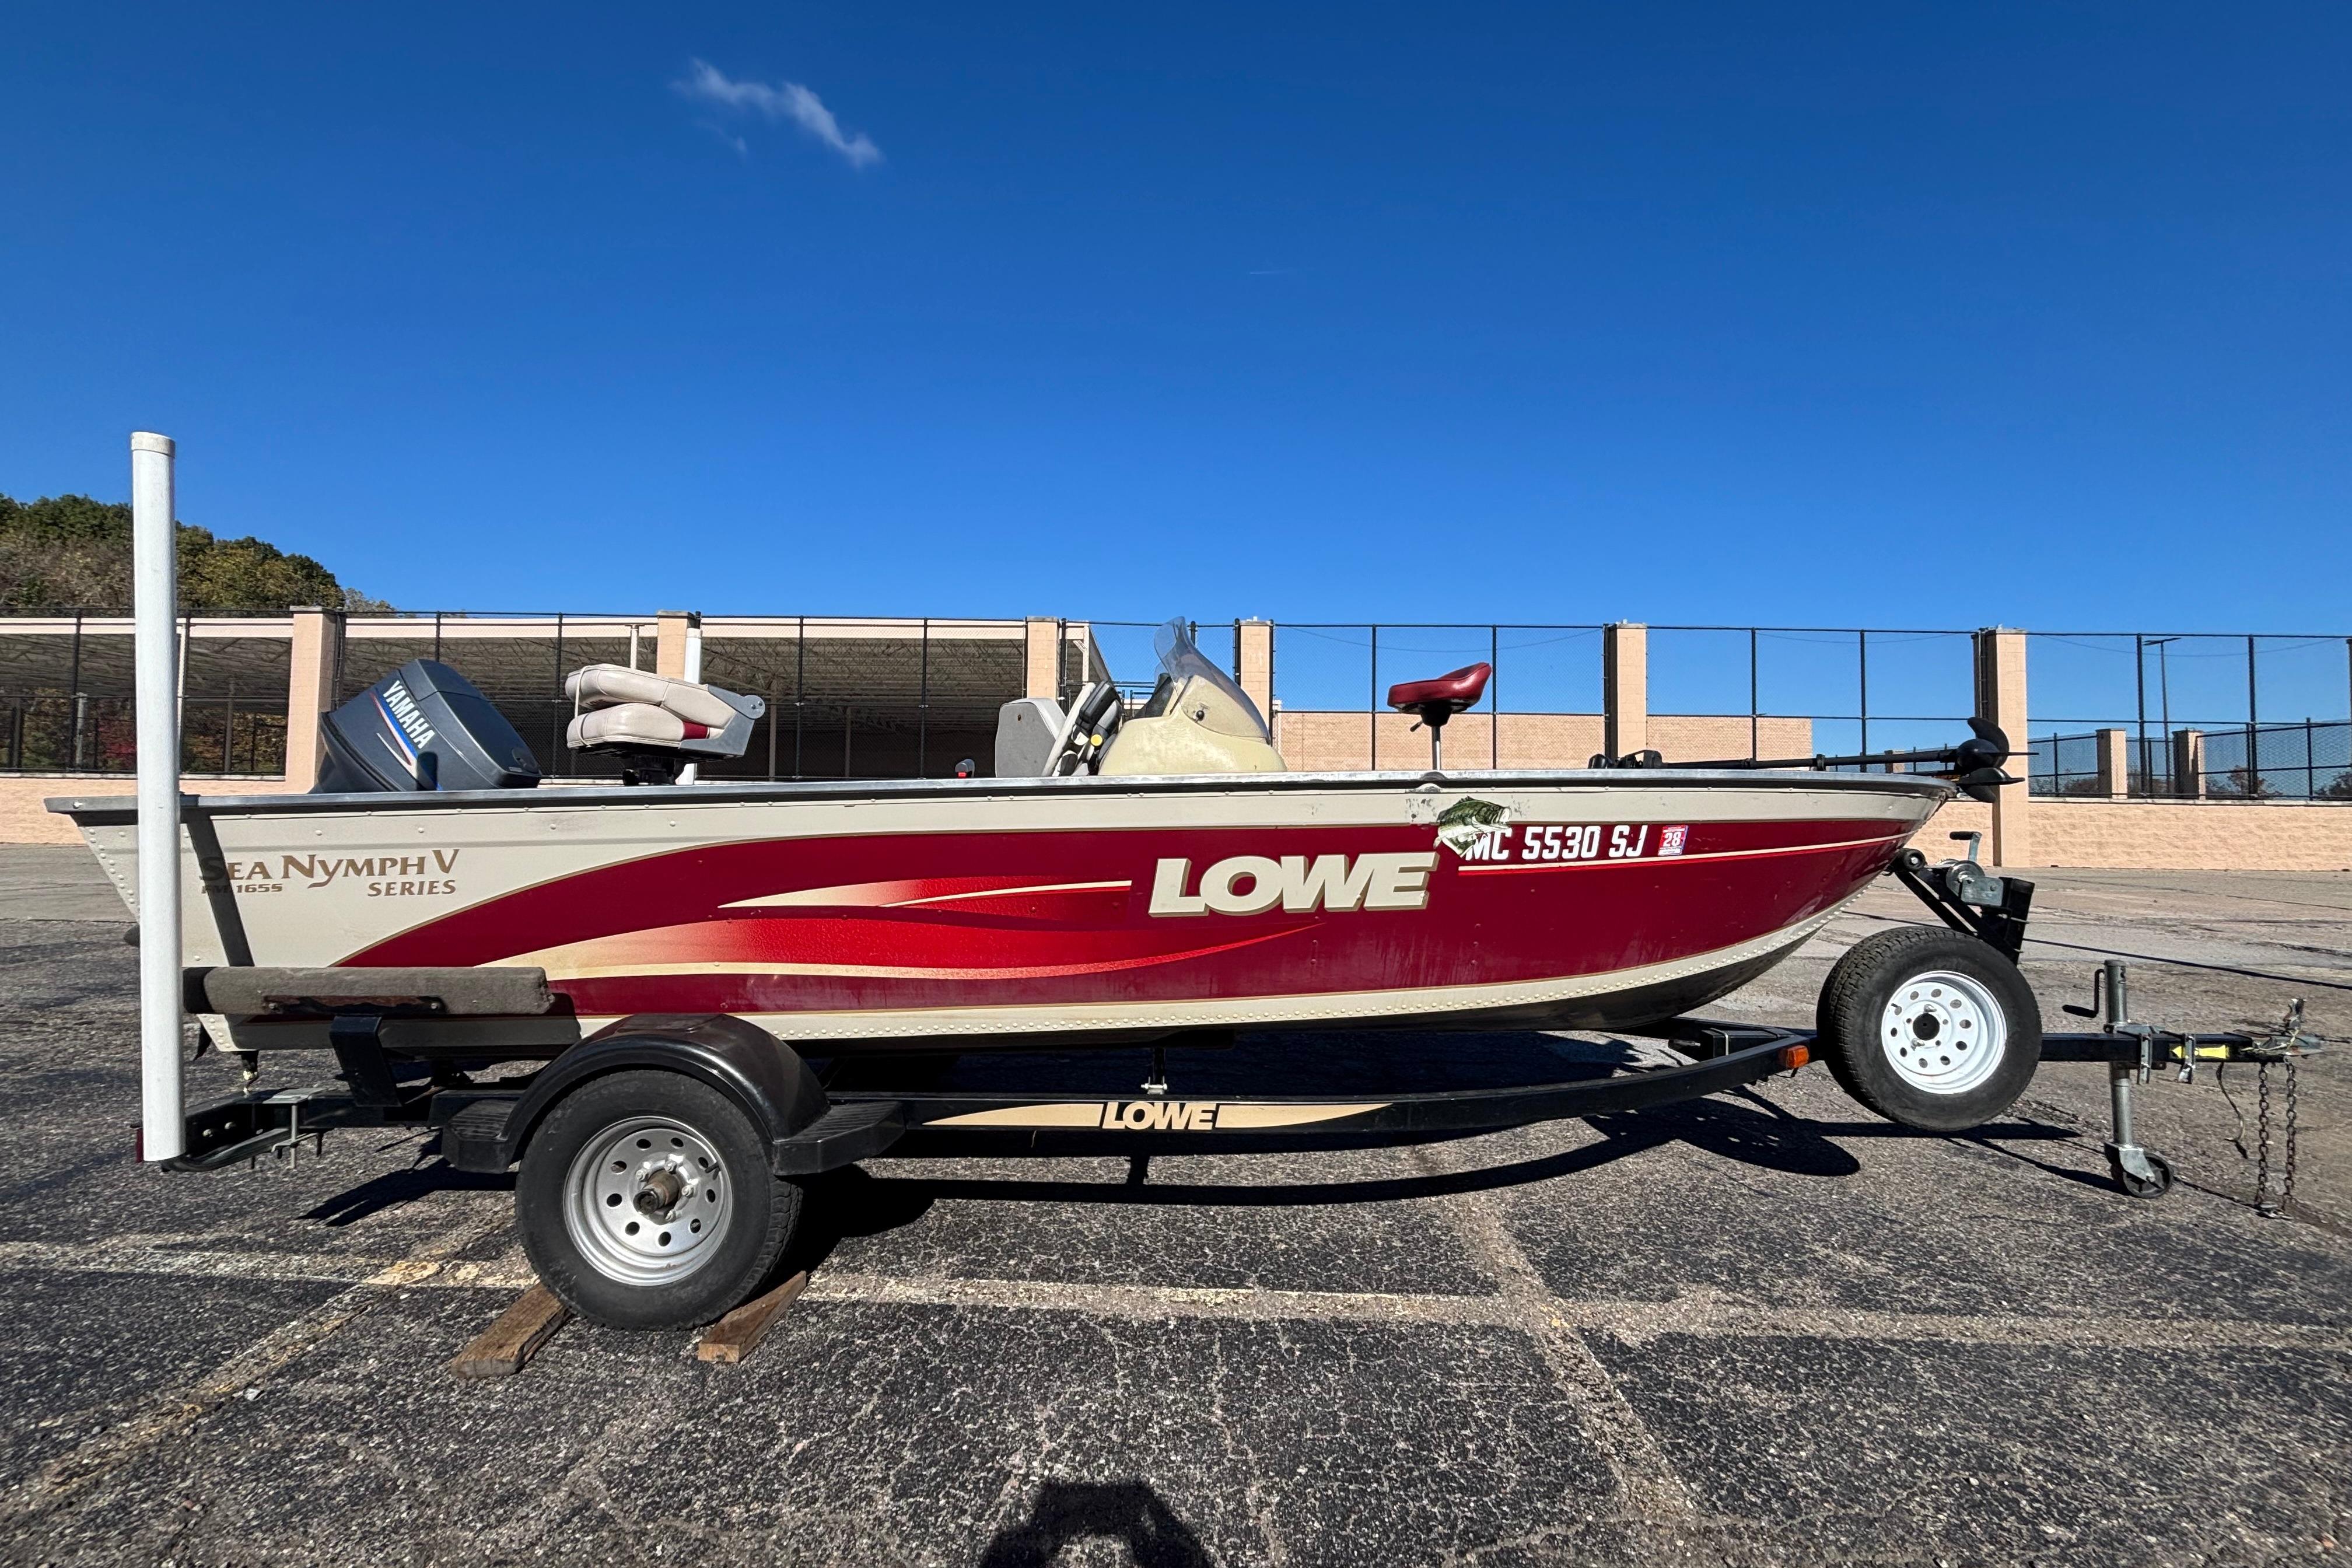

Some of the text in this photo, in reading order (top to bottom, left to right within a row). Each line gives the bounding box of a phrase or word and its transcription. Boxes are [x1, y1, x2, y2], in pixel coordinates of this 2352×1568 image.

[383, 680, 435, 750] YAMAHA
[1465, 825, 1648, 861] MC 5530 SJ
[1663, 831, 1682, 847] 28
[199, 849, 460, 889] SEA NYMPH V
[1148, 851, 1440, 918] LOWE
[368, 880, 457, 897] SERIES
[1102, 1101, 1217, 1130] LOWE
